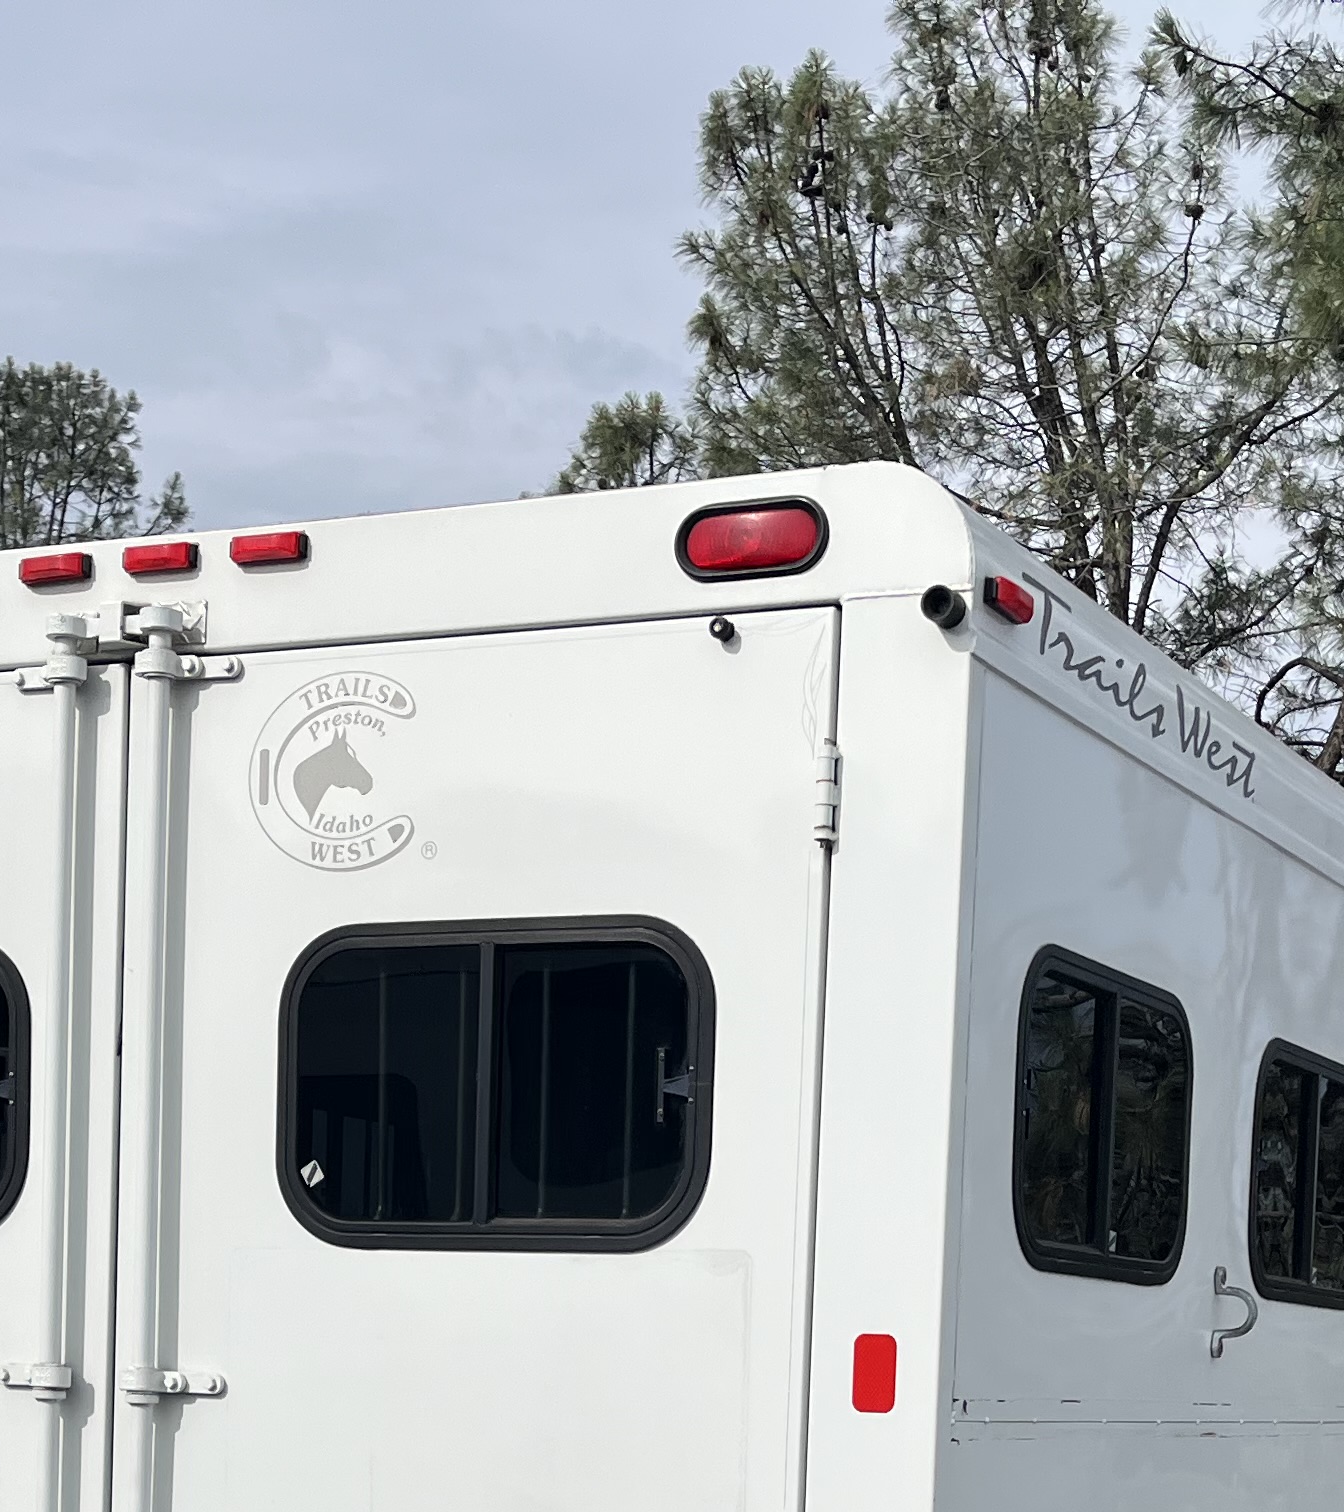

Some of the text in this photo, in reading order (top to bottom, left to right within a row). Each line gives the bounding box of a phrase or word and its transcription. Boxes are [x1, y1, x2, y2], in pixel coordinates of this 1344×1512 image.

[298, 677, 391, 711] TRAILS
[1021, 571, 1256, 799] Trails West
[307, 709, 386, 742] Preston,
[313, 812, 374, 834] Idaho
[310, 836, 376, 864] WEST
